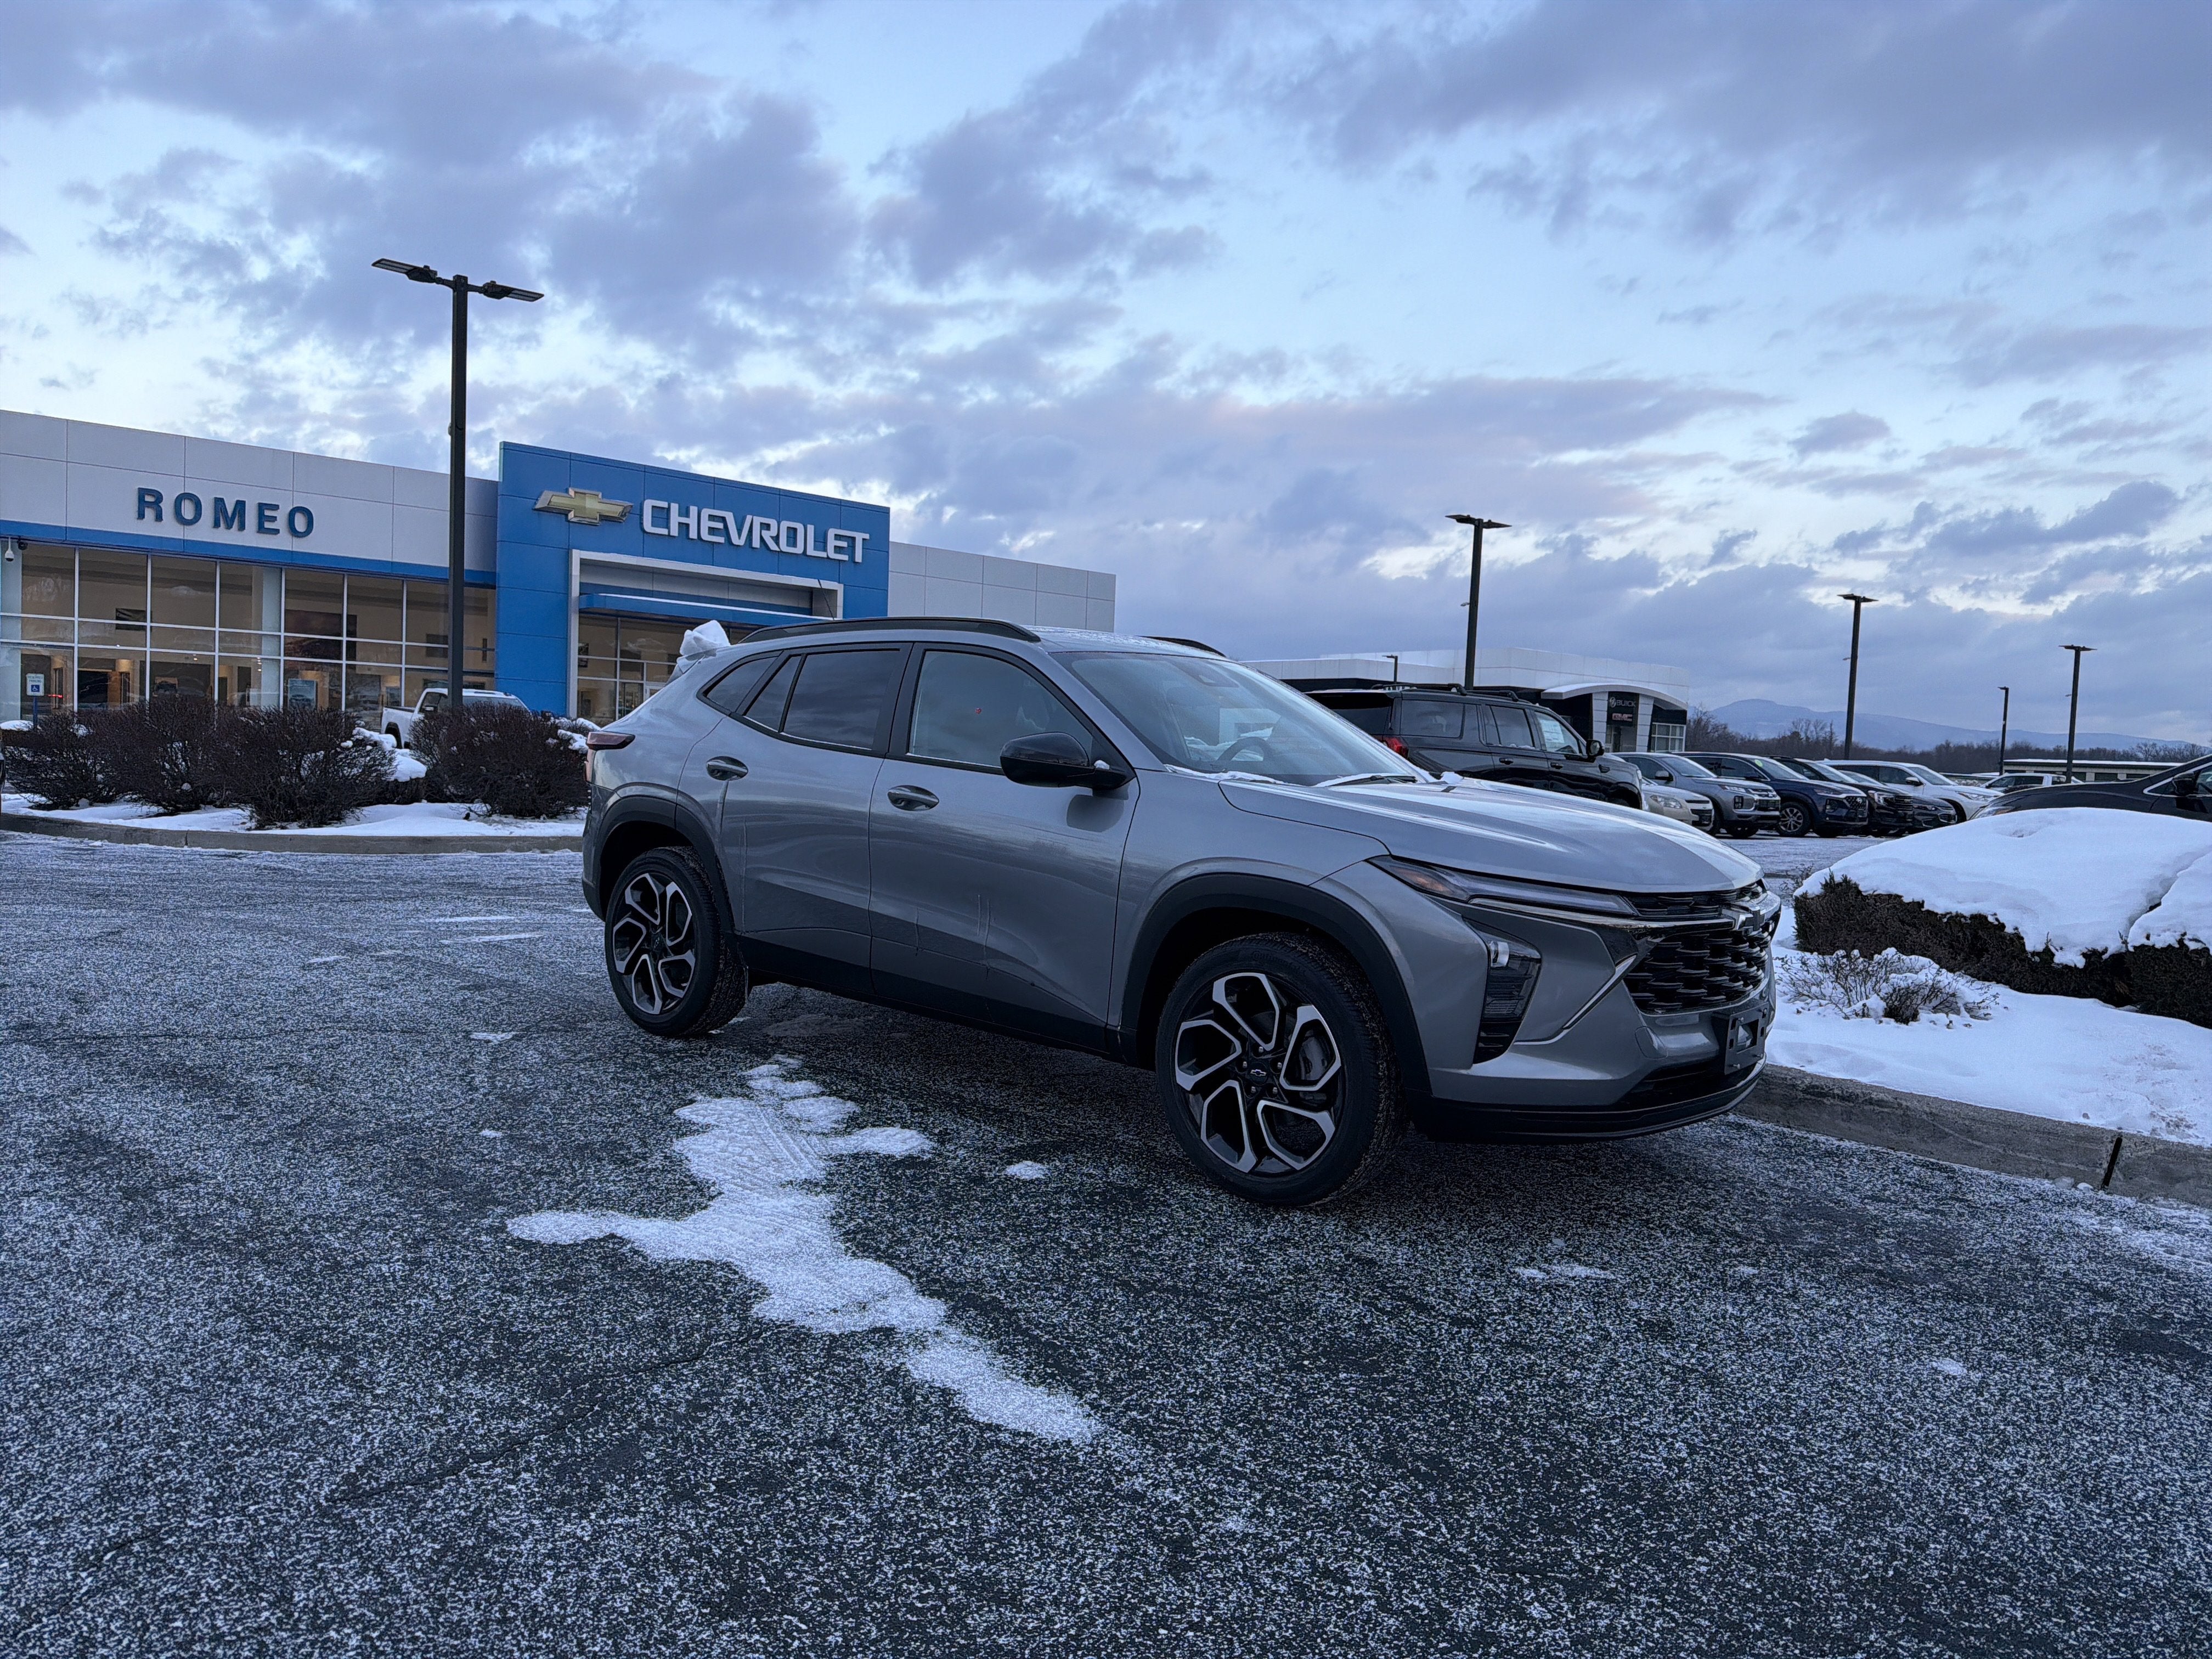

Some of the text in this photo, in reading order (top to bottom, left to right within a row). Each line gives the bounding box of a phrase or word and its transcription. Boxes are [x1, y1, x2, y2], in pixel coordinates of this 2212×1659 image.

[137, 487, 314, 538] ROMEO
[643, 499, 870, 563] CHEVROLET
[1612, 713, 1633, 722] GMC
